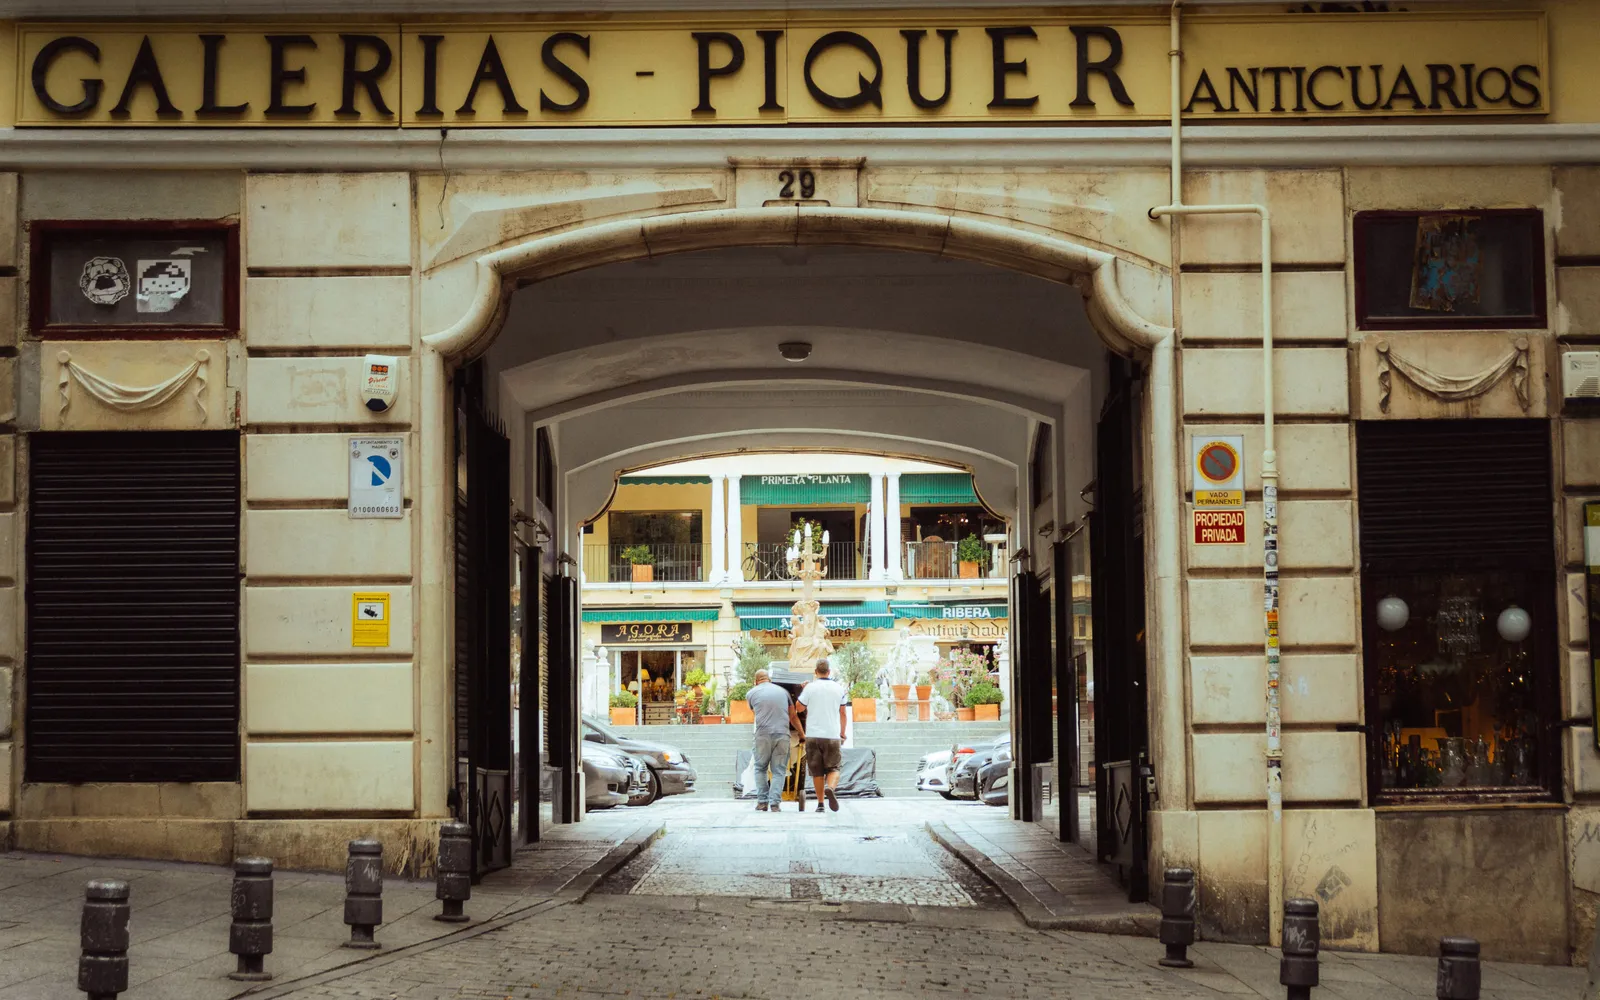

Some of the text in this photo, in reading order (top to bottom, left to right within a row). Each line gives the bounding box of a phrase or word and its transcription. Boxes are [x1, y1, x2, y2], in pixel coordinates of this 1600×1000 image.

[31, 32, 592, 118] GALERIAS
[690, 25, 1136, 115] PIQUER
[1182, 63, 1542, 113] ANTICUARIOS
[779, 170, 815, 198] 29
[761, 474, 851, 485] PRIMERA PLANTA
[1195, 513, 1243, 527] PROPIEDAD
[1201, 529, 1238, 542] PRIVADA
[942, 607, 991, 618] RIBERA
[615, 624, 680, 638] AGORA
